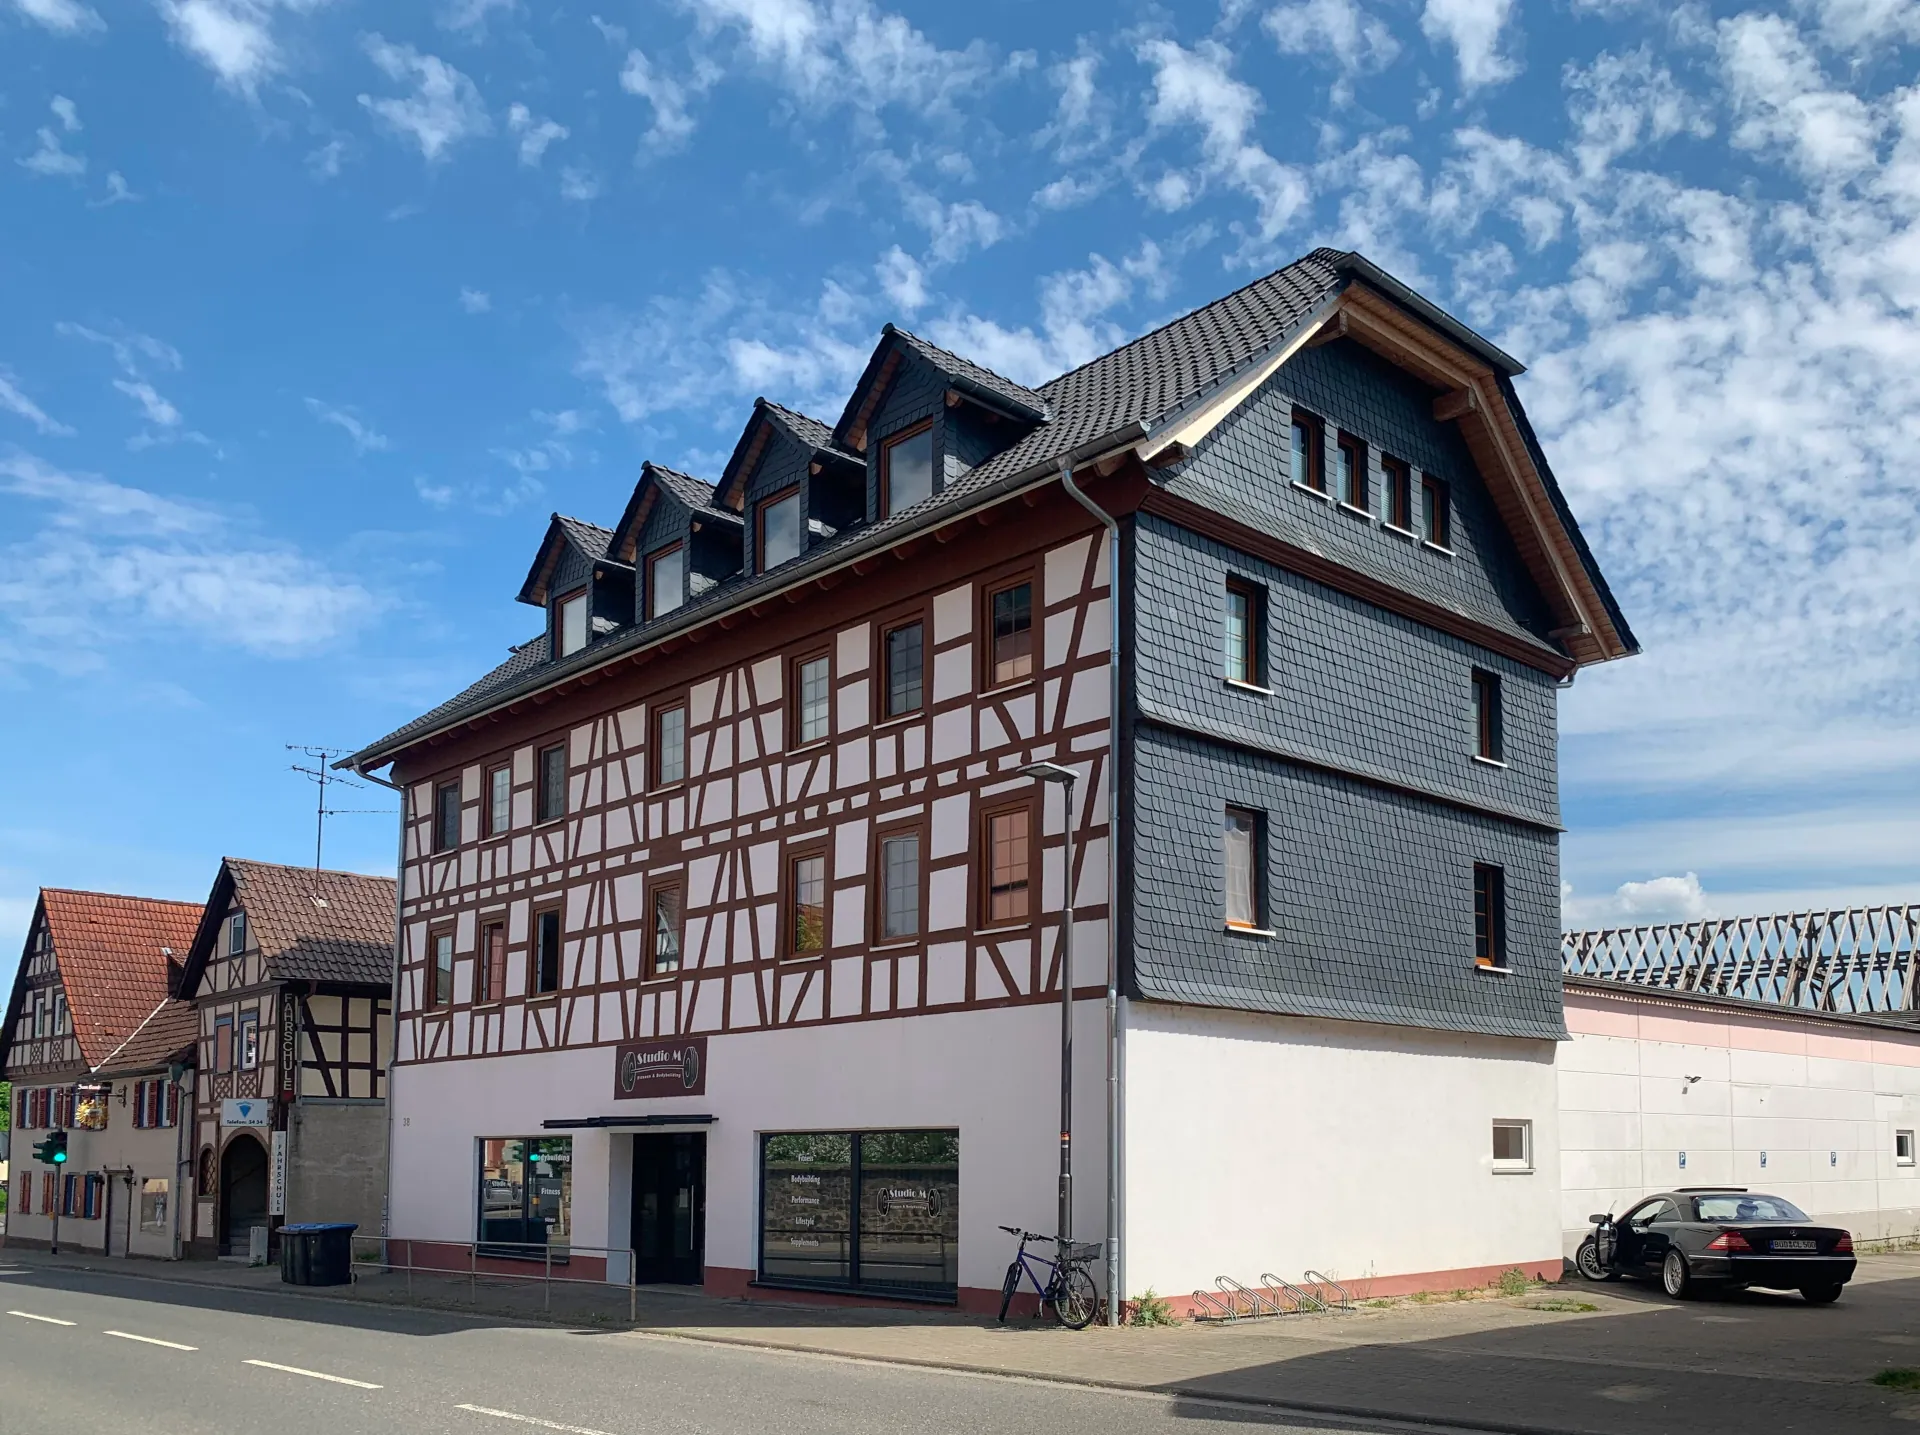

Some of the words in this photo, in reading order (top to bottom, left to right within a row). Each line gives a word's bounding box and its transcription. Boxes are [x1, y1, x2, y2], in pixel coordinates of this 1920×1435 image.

[282, 993, 293, 1091] FAHRSCHULE
[637, 1053, 670, 1065] Studio
[672, 1050, 682, 1062] M
[403, 1117, 411, 1127] 38
[533, 1154, 570, 1162] odybuilding
[791, 1175, 820, 1185] Bodybuilding
[889, 1189, 917, 1198] Studio
[918, 1190, 926, 1199] M
[791, 1196, 820, 1204] Performance
[795, 1217, 815, 1226] Lifestyle
[790, 1238, 819, 1247] Supplements
